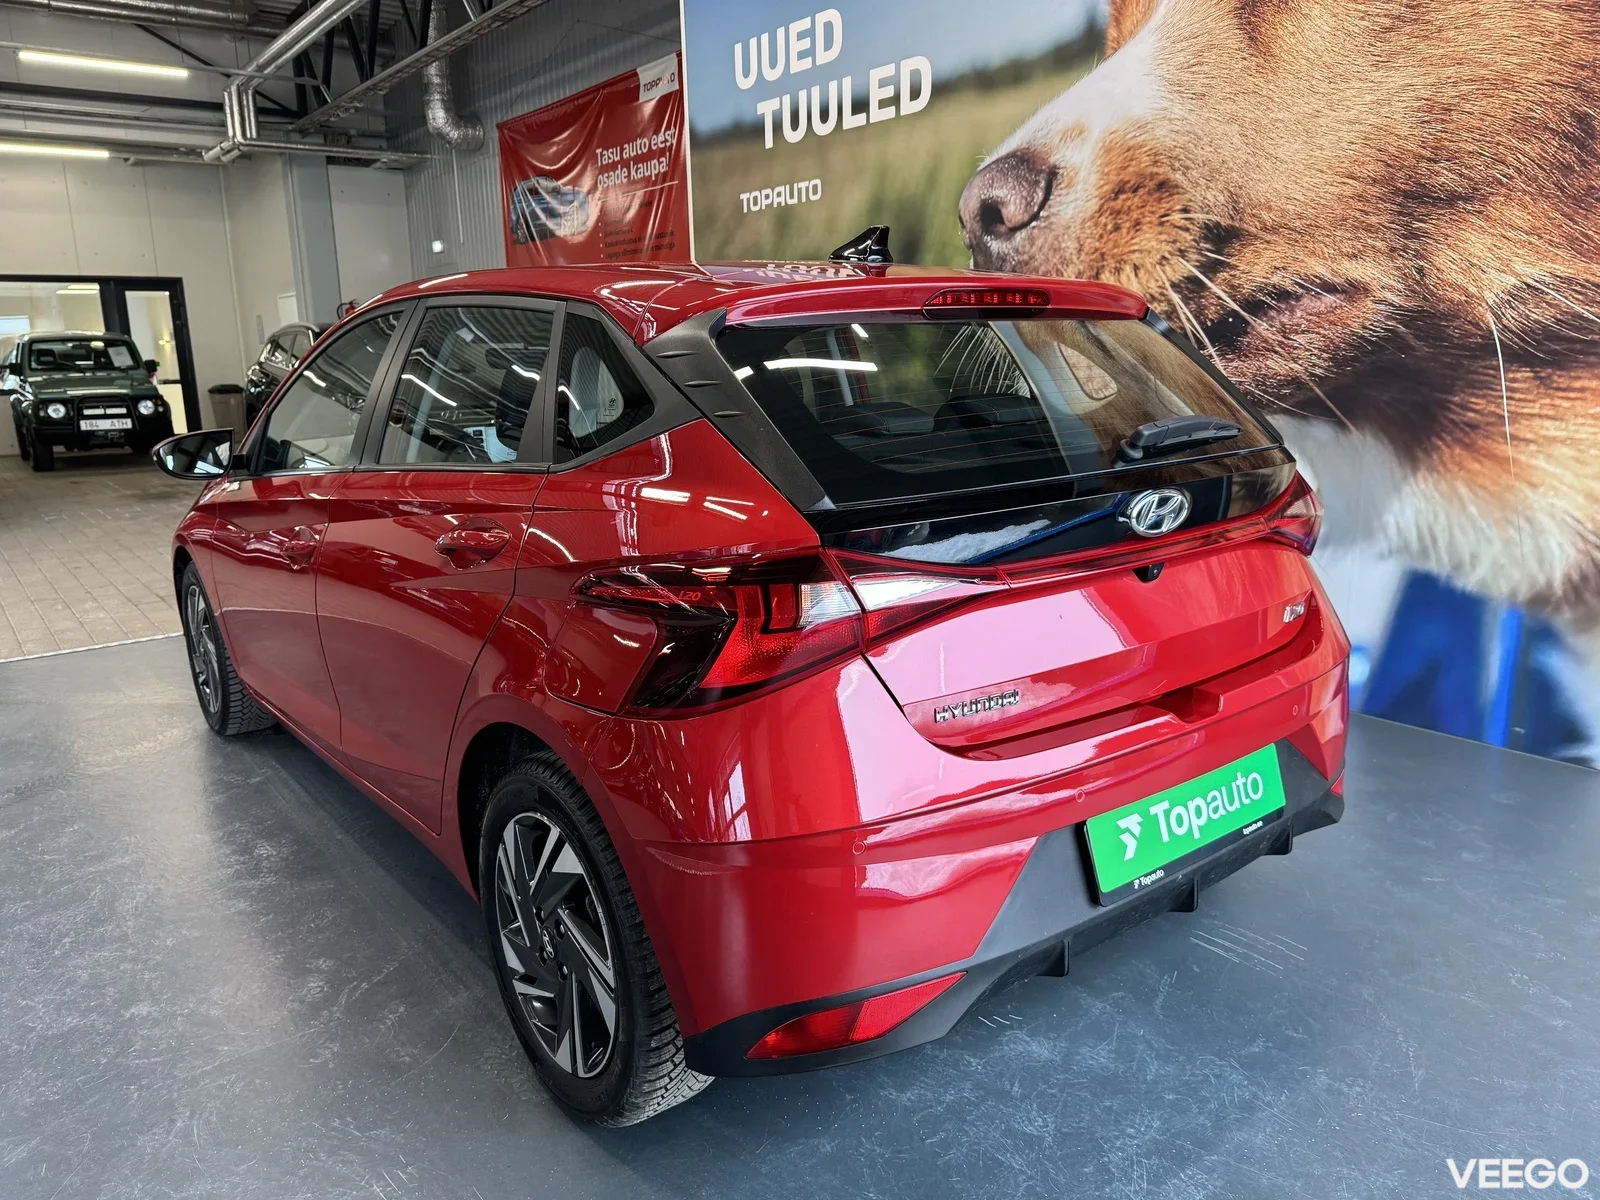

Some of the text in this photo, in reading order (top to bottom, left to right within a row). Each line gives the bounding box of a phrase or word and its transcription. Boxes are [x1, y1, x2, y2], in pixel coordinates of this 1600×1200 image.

[734, 8, 843, 90] UUED
[756, 55, 932, 150] TUULED
[596, 127, 675, 167] Tasu auto eest
[597, 151, 669, 189] osade kaupa!
[739, 178, 822, 214] TOPAUTO
[84, 420, 128, 429] 184 ATH
[934, 689, 1020, 724] HYUNDAI
[1149, 771, 1264, 843] Topauto
[1140, 869, 1165, 886] Topauto
